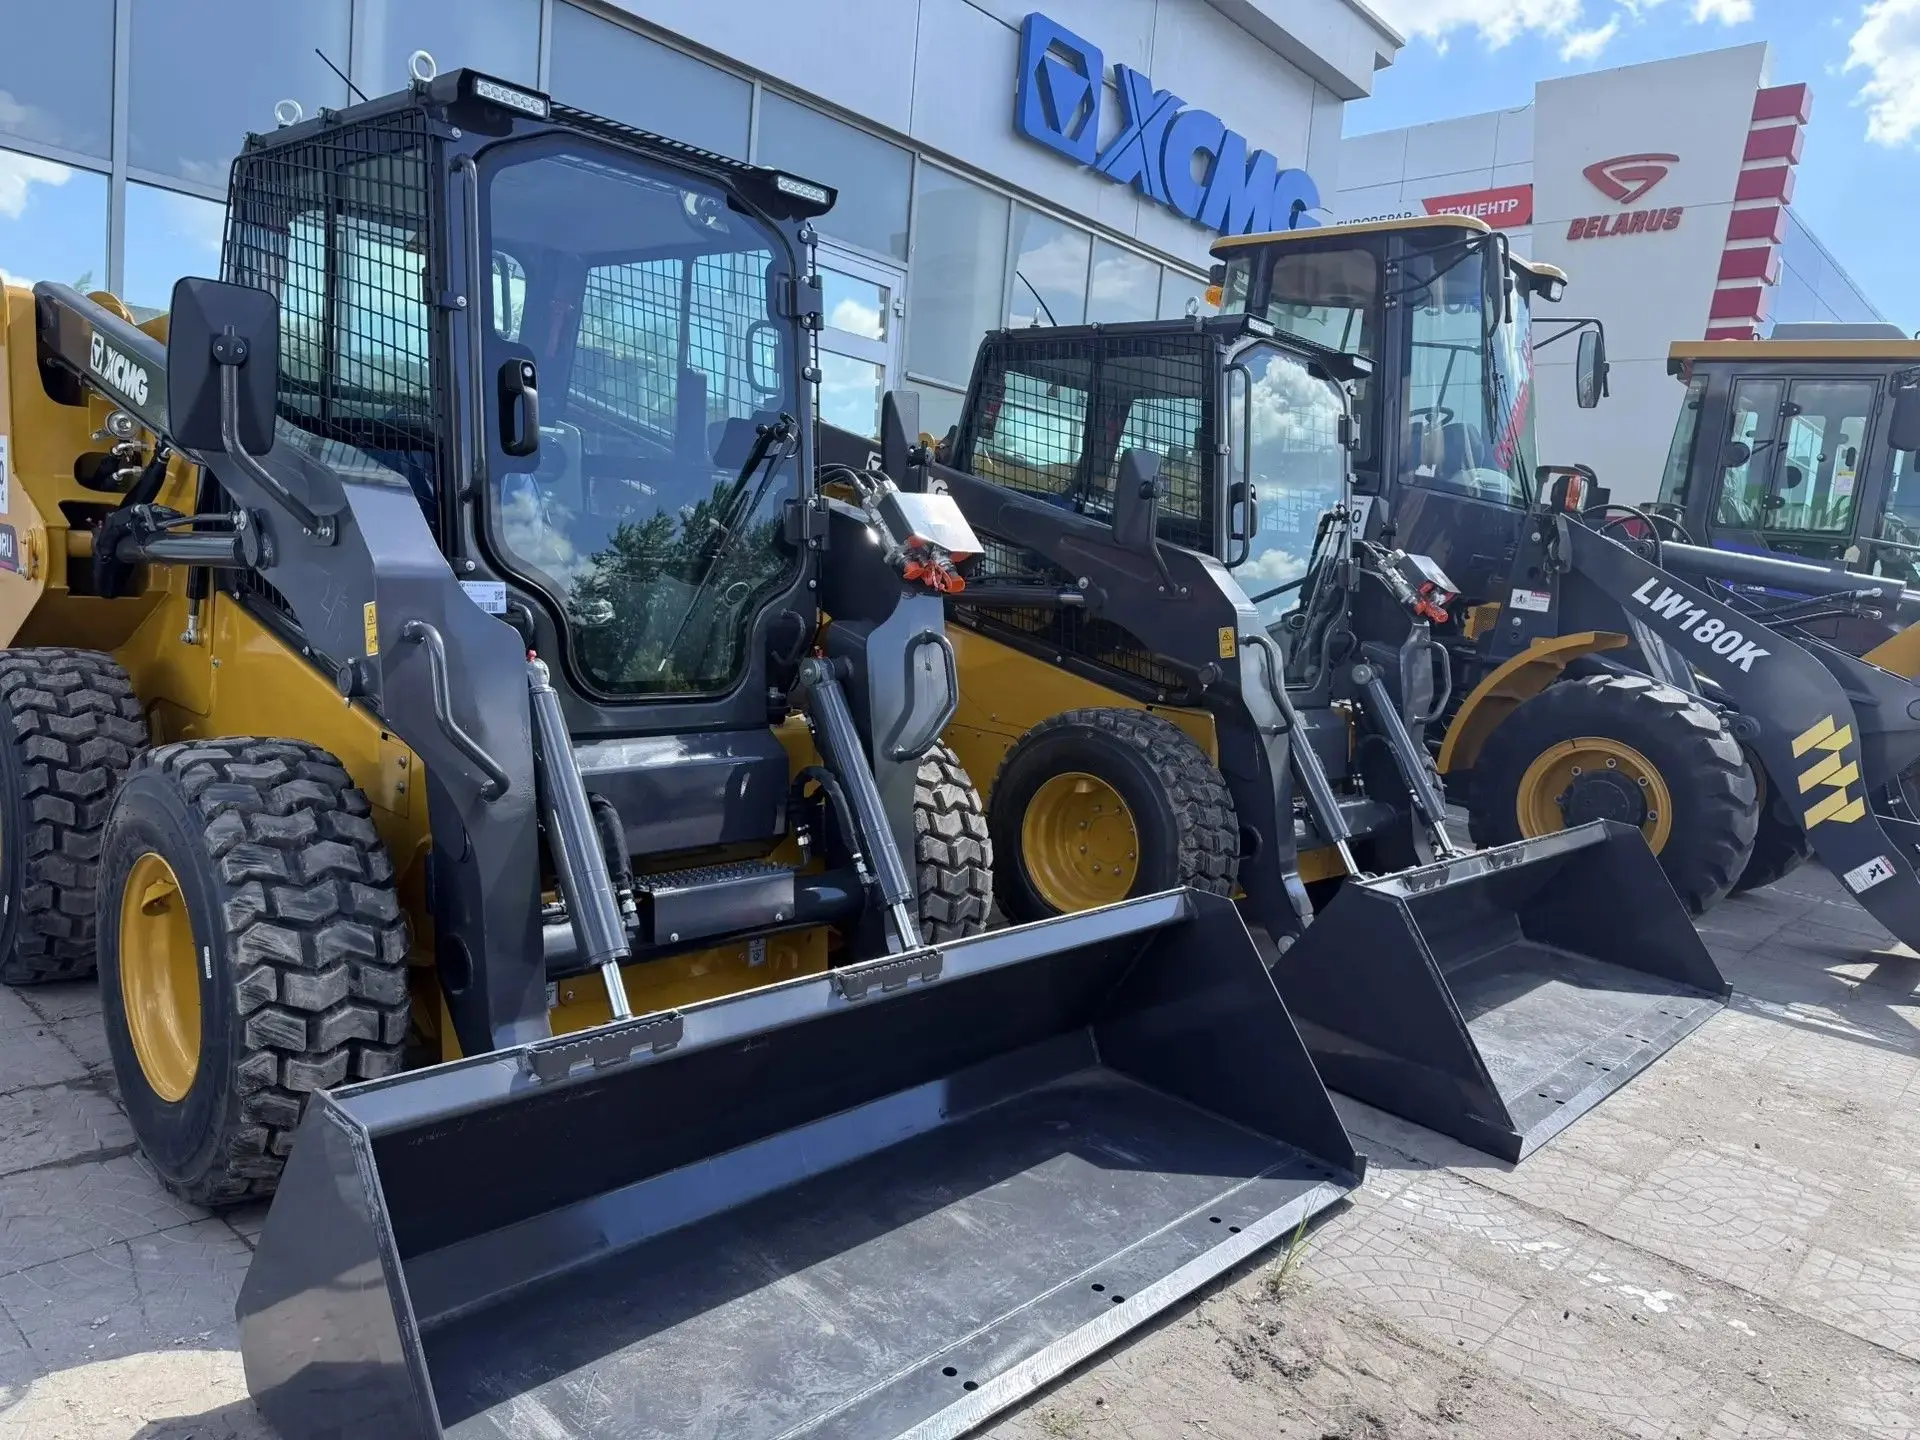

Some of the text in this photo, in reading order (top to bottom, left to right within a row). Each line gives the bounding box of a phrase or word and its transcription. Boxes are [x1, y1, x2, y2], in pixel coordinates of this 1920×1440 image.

[1096, 63, 1320, 235] XCMG
[1567, 207, 1683, 240] BELARUS
[102, 345, 148, 406] XCMG
[1631, 577, 1771, 673] LW180K
